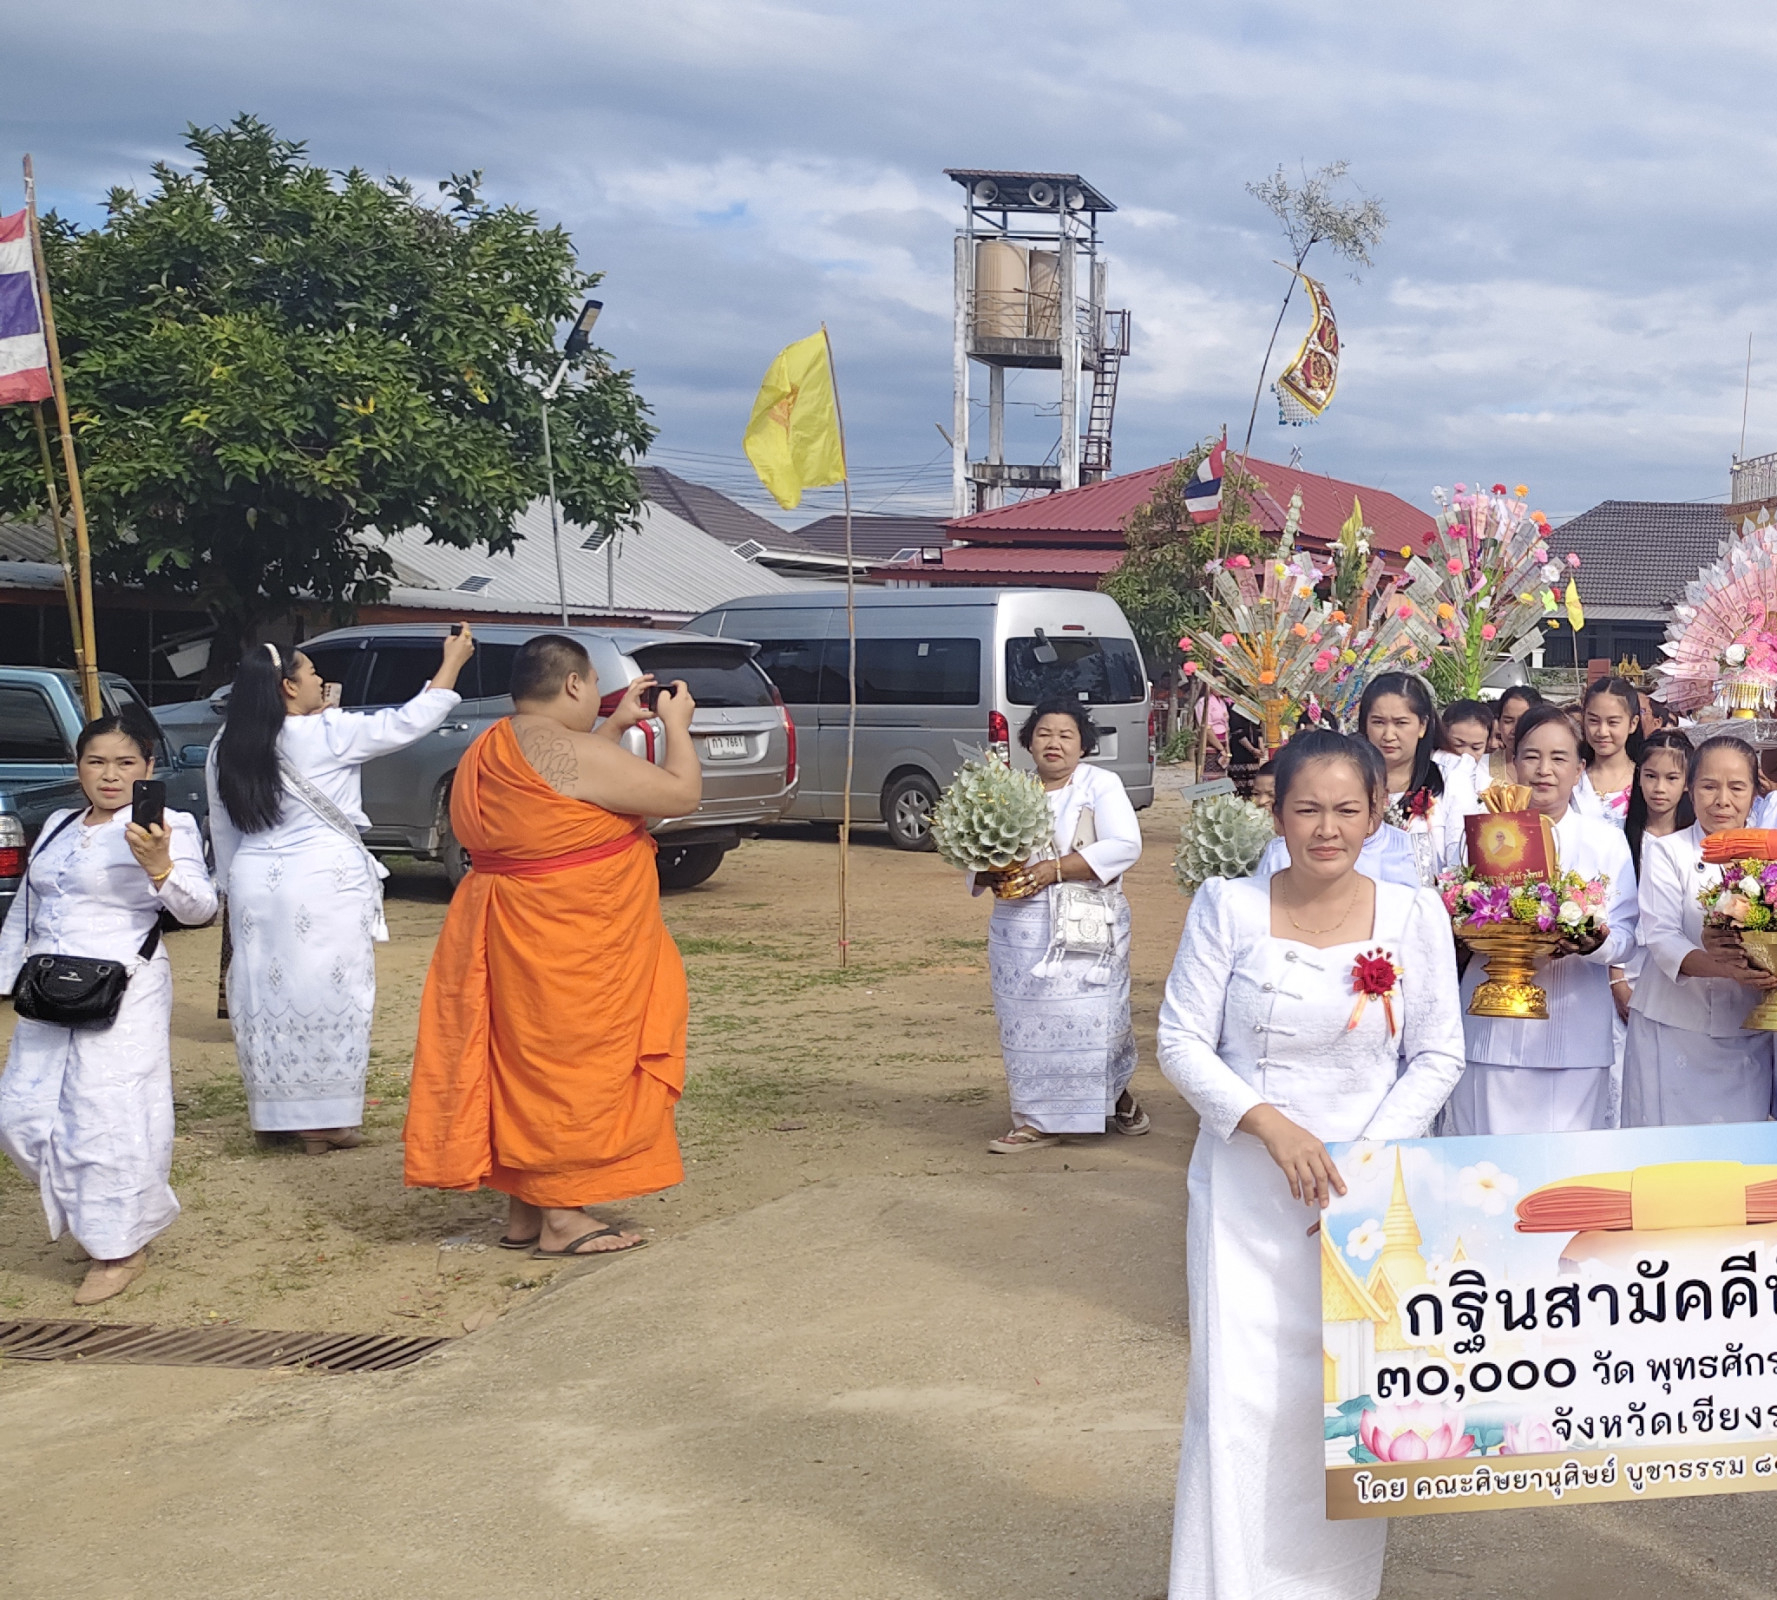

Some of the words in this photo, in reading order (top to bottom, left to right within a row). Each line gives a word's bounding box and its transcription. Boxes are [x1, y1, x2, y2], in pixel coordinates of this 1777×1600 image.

[1376, 1357, 1577, 1403] ๓๐,๐๐๐
[1592, 1349, 1635, 1386] วัด
[1357, 1474, 1406, 1501] โดย
[1416, 1456, 1616, 1497] คณะศิษยานุศิษย์
[1626, 1456, 1744, 1491] บูชาธรรม
